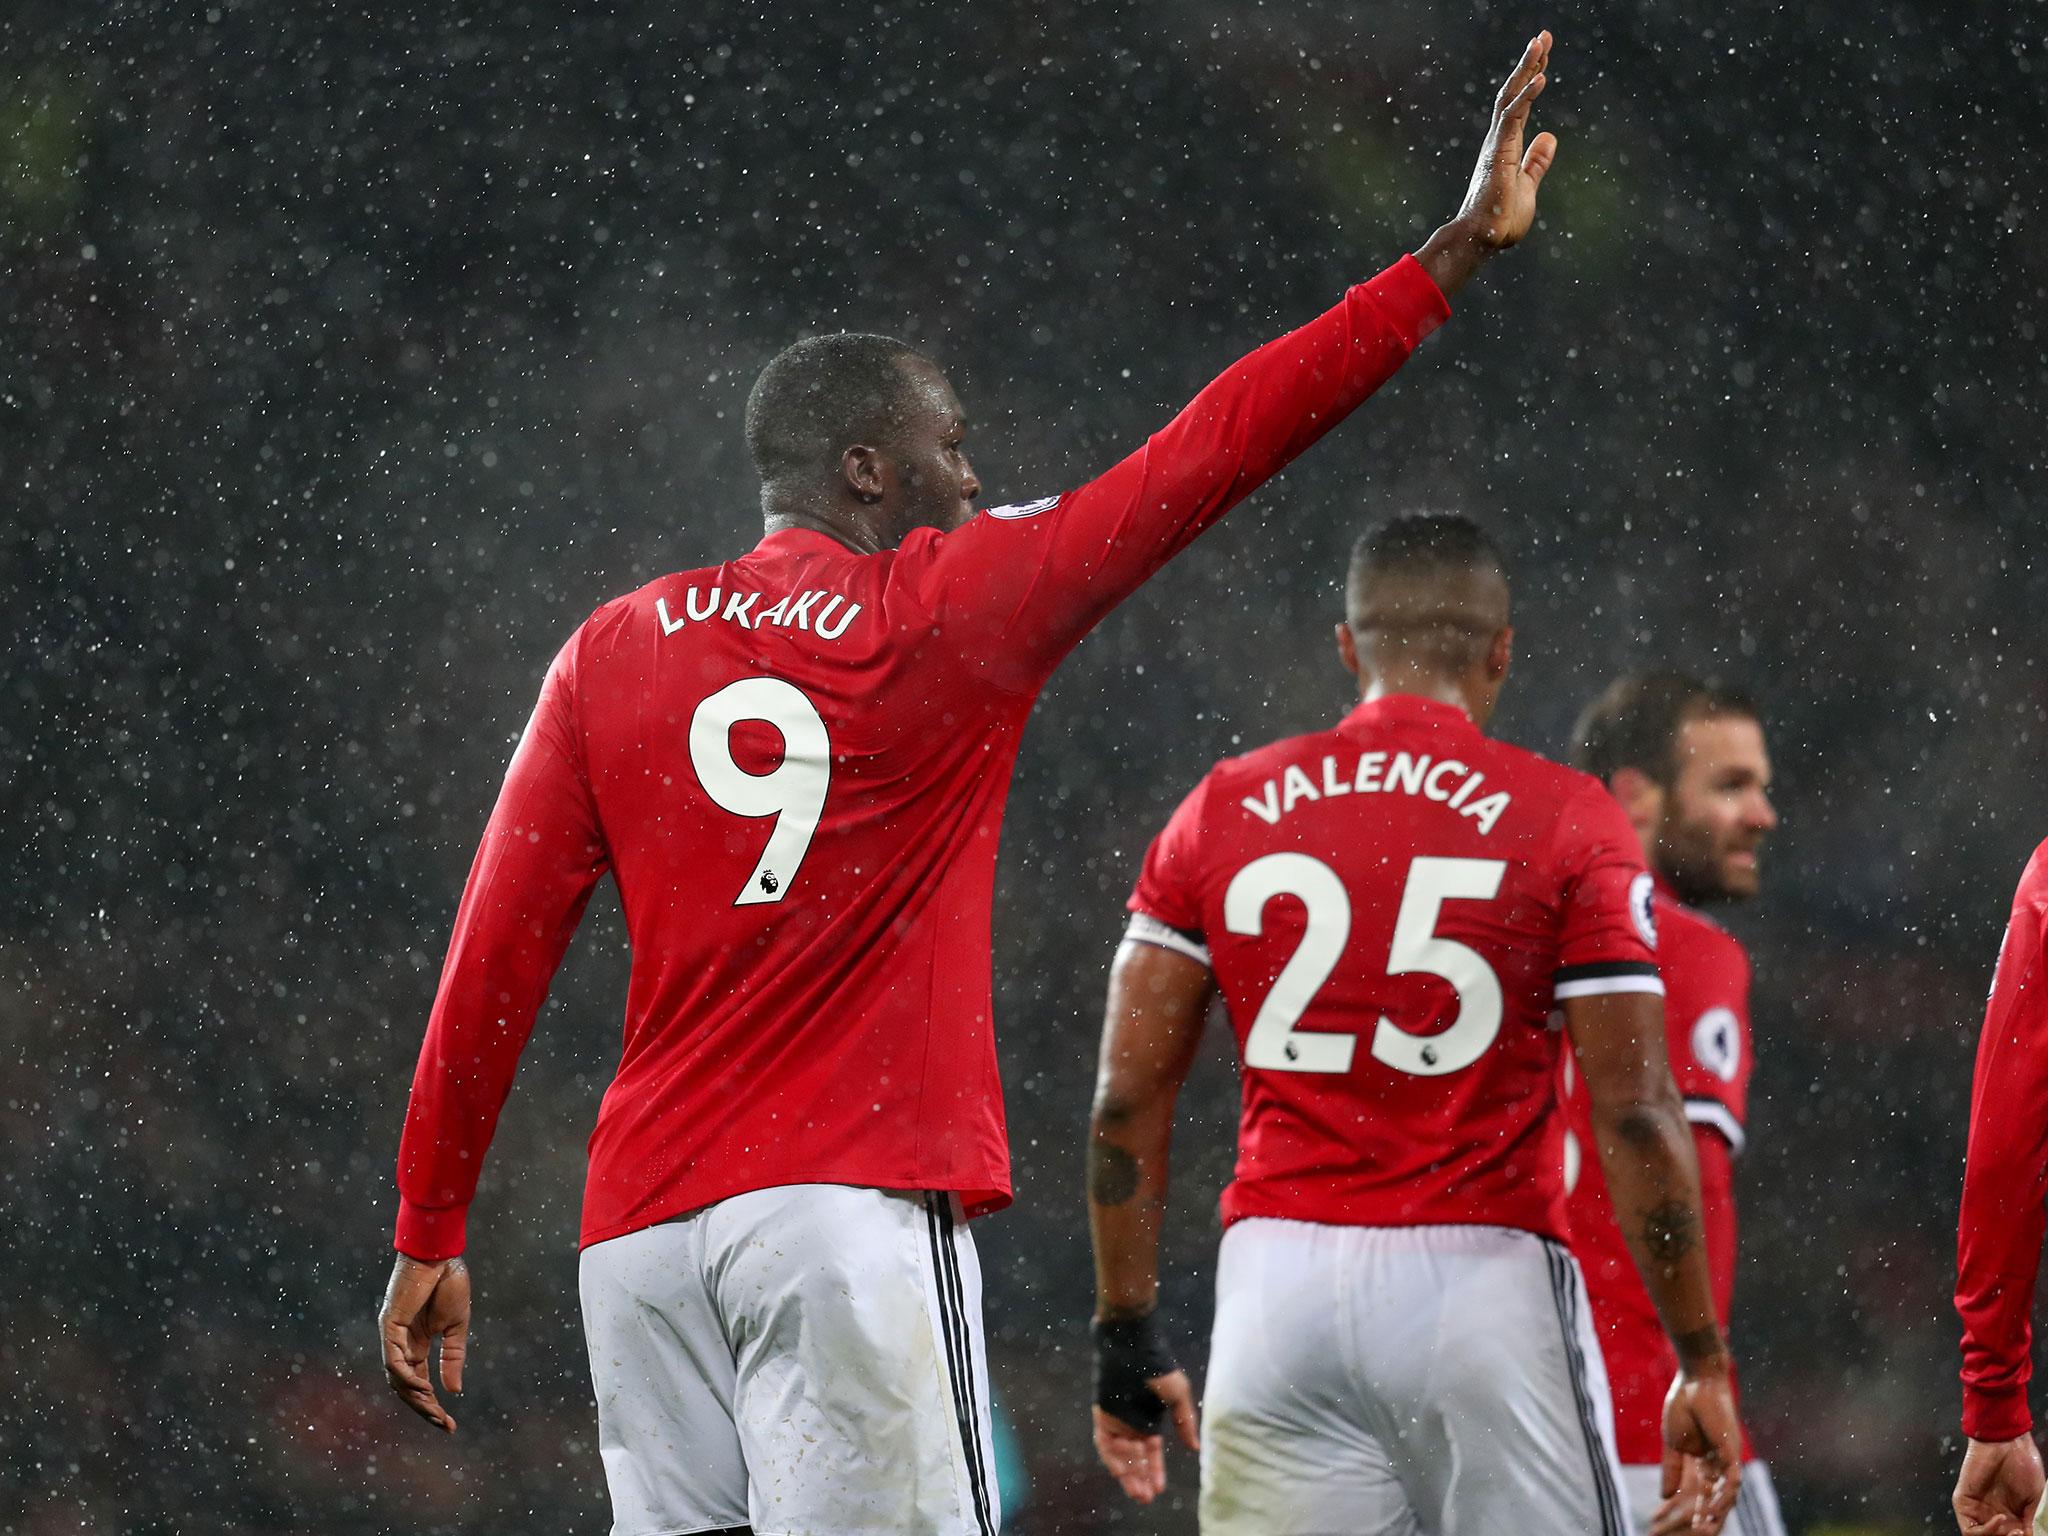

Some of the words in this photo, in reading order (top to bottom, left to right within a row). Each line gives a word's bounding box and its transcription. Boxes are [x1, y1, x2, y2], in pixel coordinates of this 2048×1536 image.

[655, 586, 862, 640] LUKAKU
[689, 676, 831, 905] 9
[1241, 751, 1511, 836] VALENCIA
[1223, 851, 1507, 1076] 25
